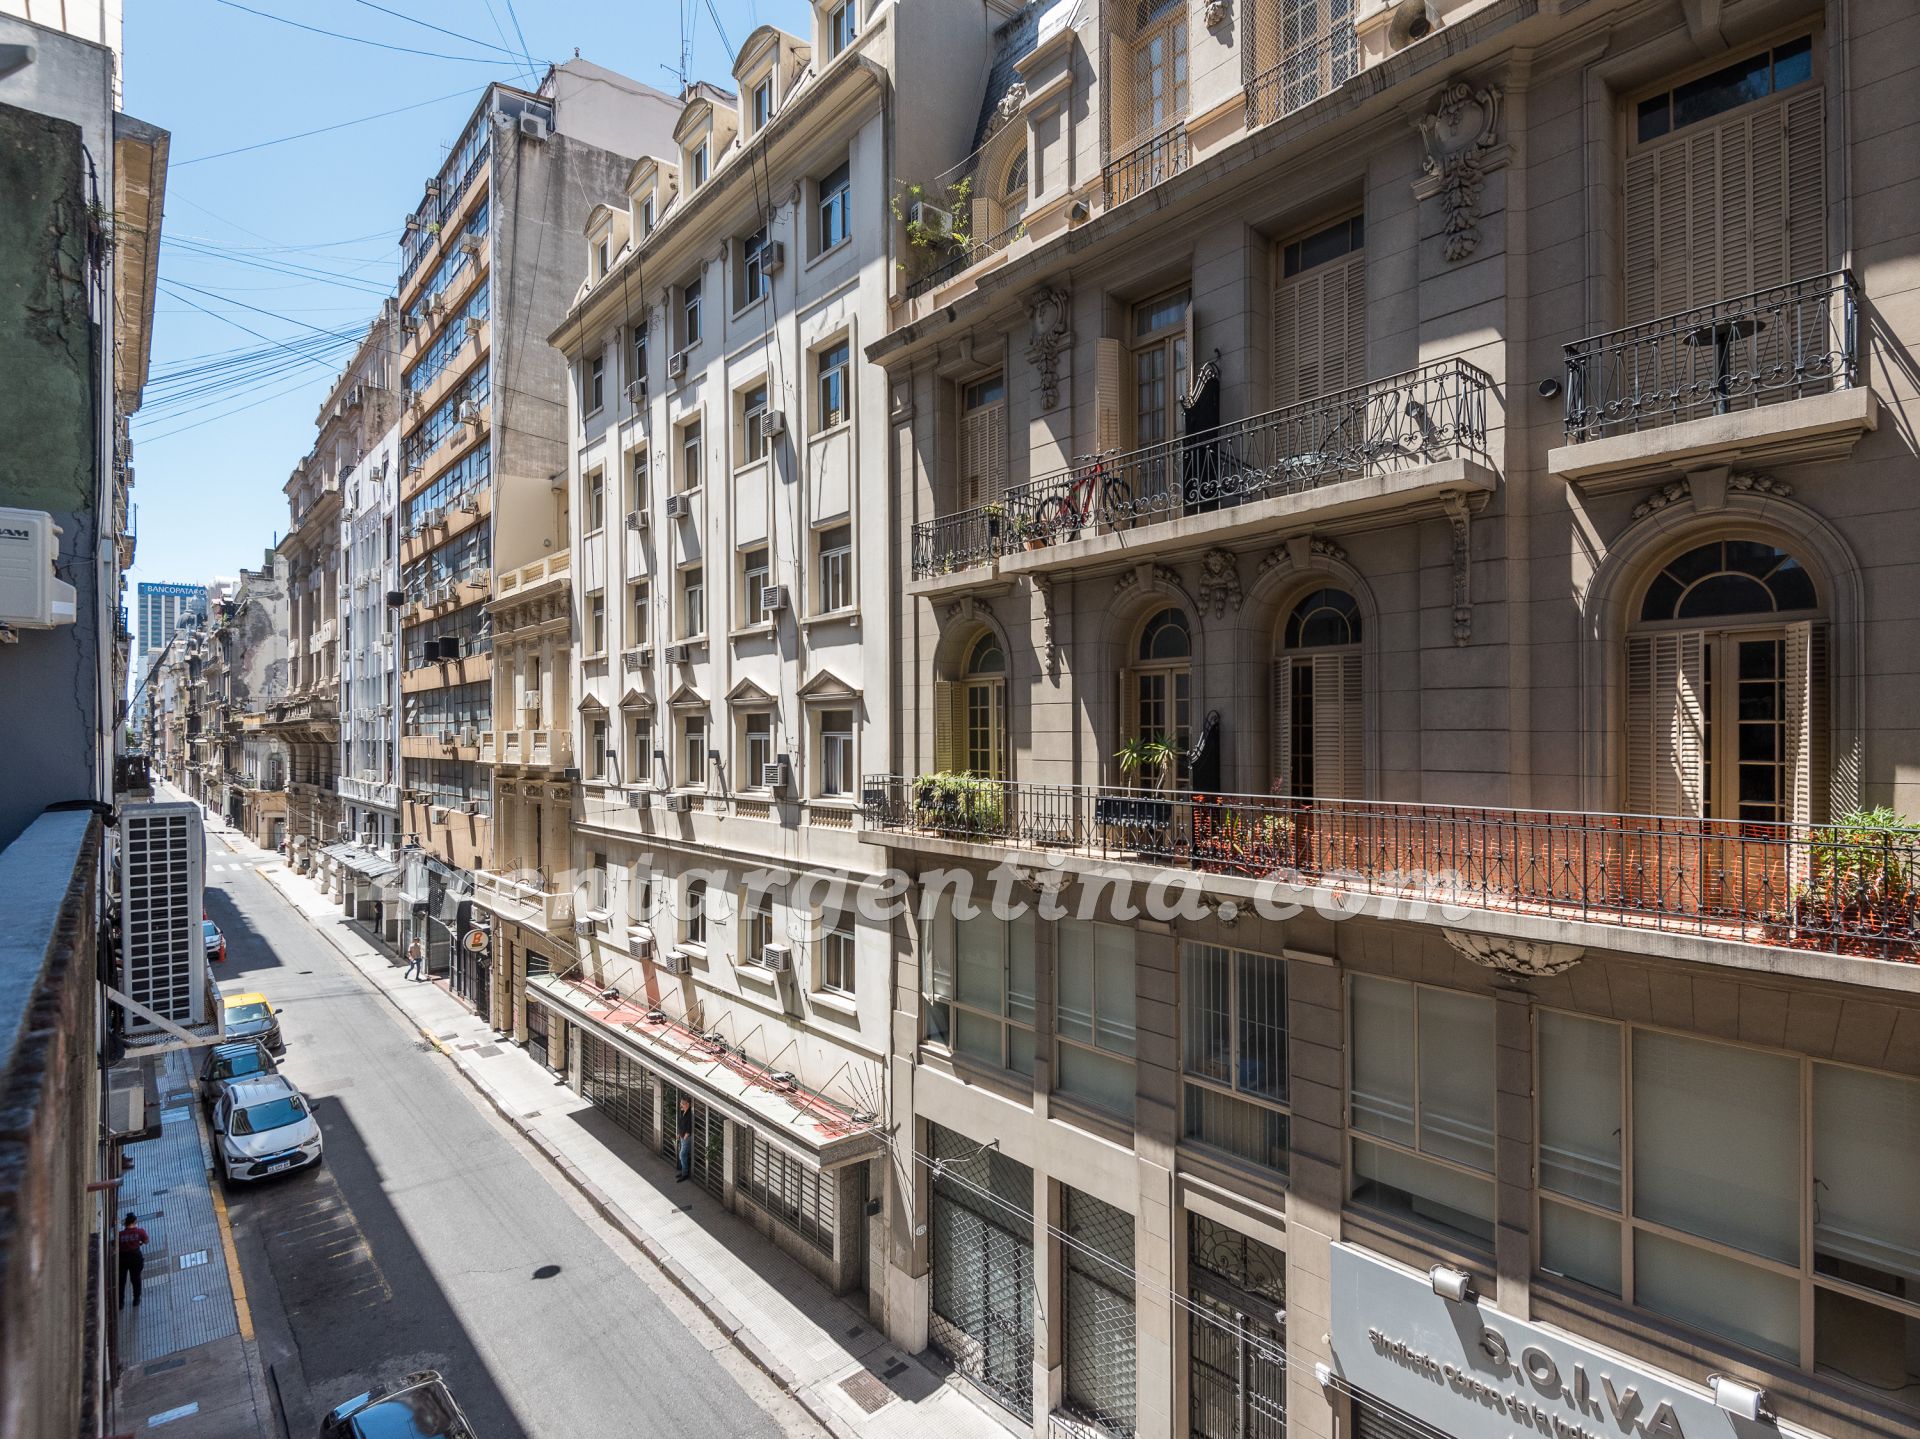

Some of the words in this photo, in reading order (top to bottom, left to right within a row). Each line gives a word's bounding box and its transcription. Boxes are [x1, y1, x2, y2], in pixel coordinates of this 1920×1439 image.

[1369, 1328, 1440, 1371] Sindicato
[1443, 1364, 1501, 1400] Obrero
[1505, 1392, 1528, 1413] de
[1531, 1402, 1548, 1424] la
